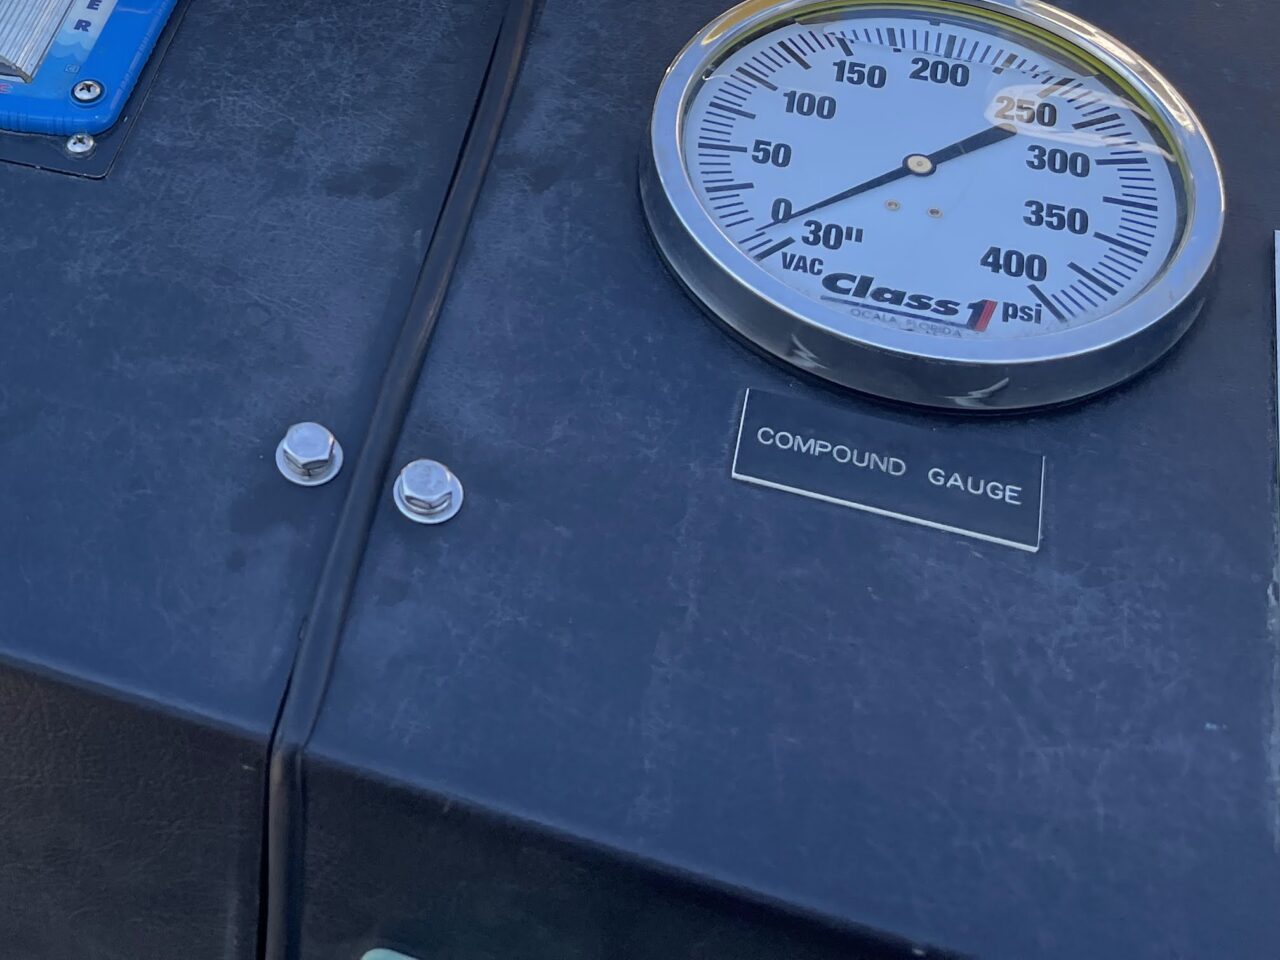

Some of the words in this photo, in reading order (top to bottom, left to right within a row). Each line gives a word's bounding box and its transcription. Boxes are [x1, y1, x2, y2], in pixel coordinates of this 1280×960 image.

[833, 59, 887, 89] 150
[910, 56, 970, 88] 200
[782, 90, 837, 120] 100
[994, 94, 1058, 128] 250
[752, 139, 792, 168] 50
[1025, 144, 1091, 177] 300
[771, 198, 793, 224] 0
[1023, 199, 1089, 235] 350
[801, 219, 864, 250] 30"
[781, 251, 824, 276] VAC
[979, 246, 1048, 282] 400
[1001, 301, 1044, 325] psi
[756, 426, 907, 477] COMPOUND
[927, 467, 1023, 505] GAUGE
